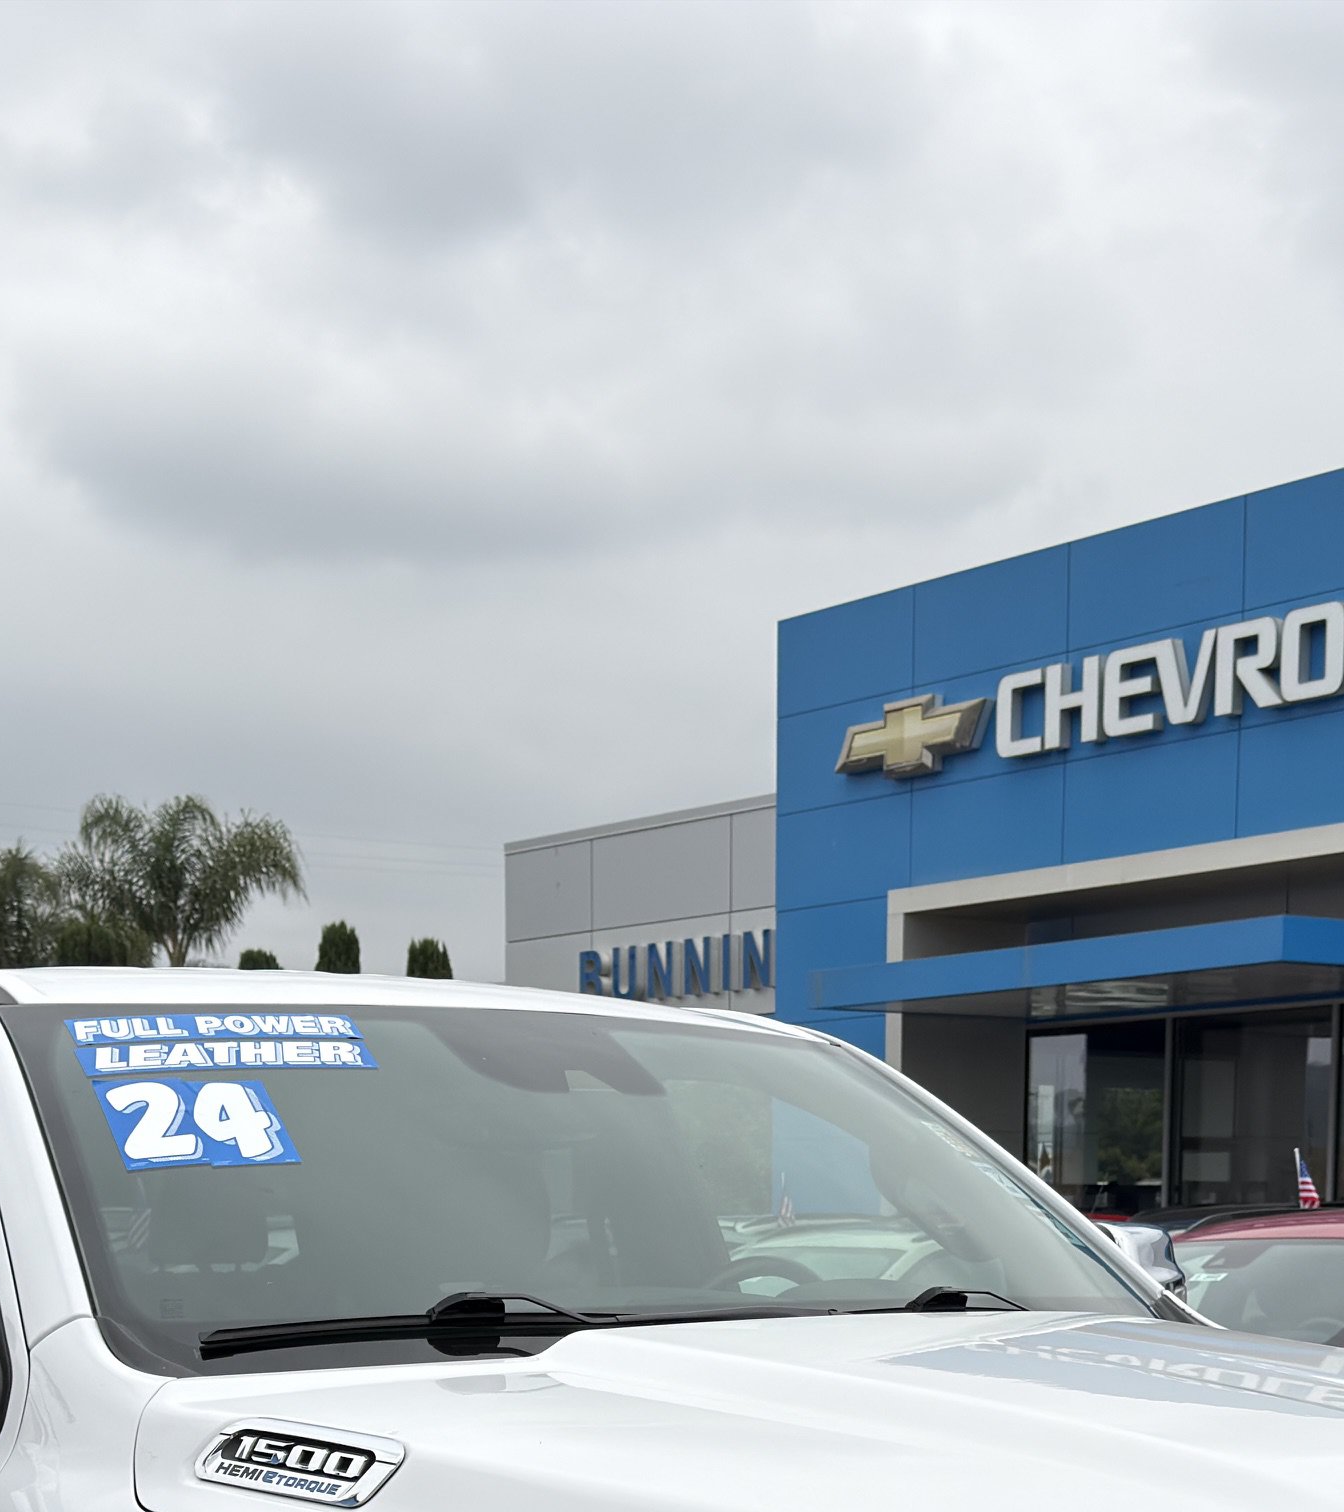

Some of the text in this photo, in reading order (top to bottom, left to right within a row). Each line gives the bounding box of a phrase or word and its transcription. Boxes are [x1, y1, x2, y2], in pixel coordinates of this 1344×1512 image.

[578, 928, 773, 1000] BUNNIN
[73, 1015, 353, 1041] FULL POWER
[94, 1041, 361, 1070] LEATHER
[105, 1081, 281, 1161] 24
[215, 1462, 264, 1482] HEMI
[233, 1435, 367, 1478] 1500
